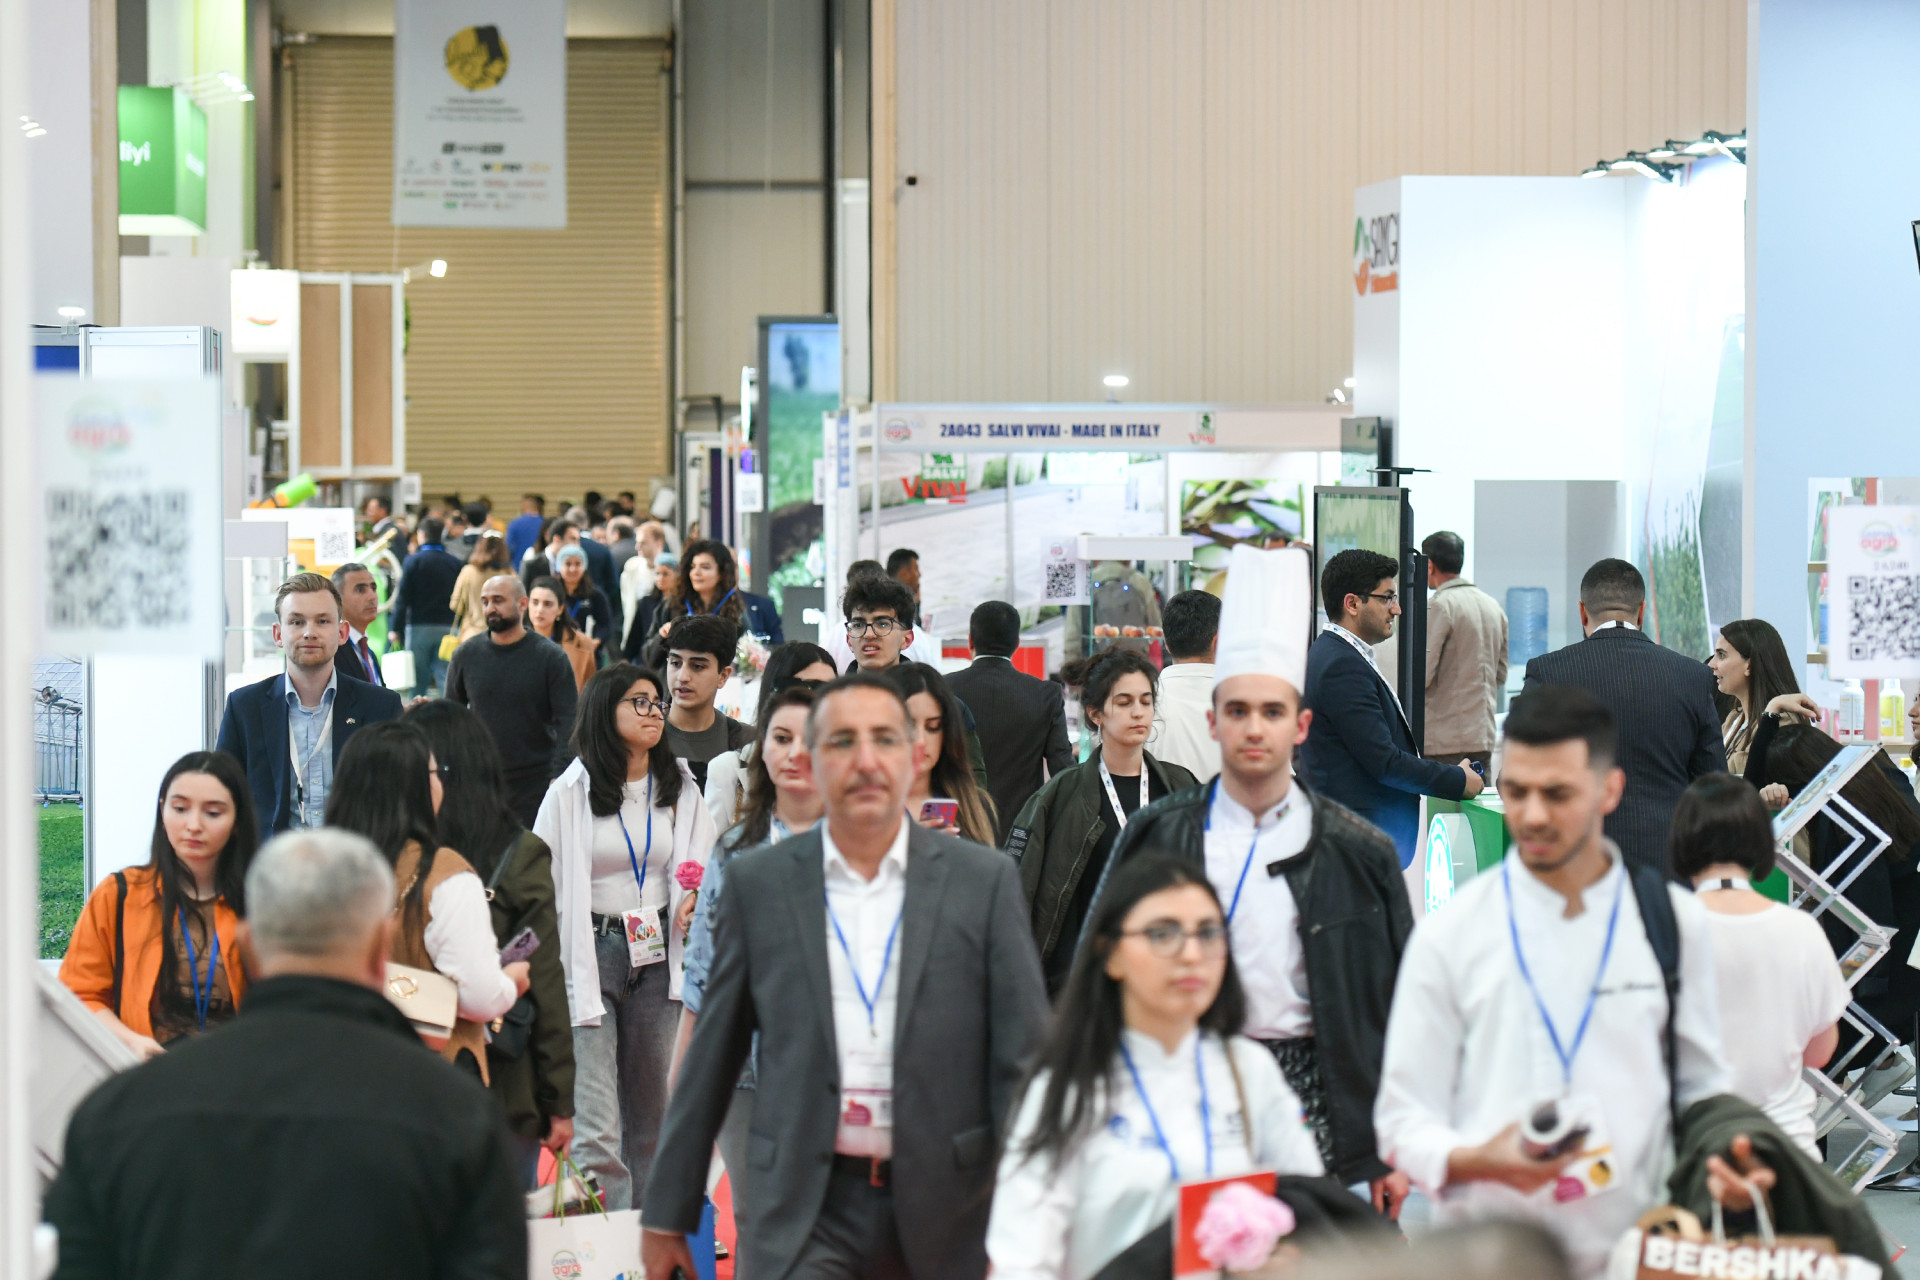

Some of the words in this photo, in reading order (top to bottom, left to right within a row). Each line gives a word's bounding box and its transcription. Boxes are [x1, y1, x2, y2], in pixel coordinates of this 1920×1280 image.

[940, 424, 981, 438] 2A043
[988, 424, 1023, 437] SALVI
[1027, 424, 1061, 437] VIVAI
[1072, 424, 1106, 437] MADE
[1110, 424, 1123, 437] IN
[1126, 424, 1160, 437] ITALY
[922, 468, 965, 479] SALVI
[901, 475, 966, 498] VIVAI
[1644, 1235, 1841, 1280] BERSHKA
